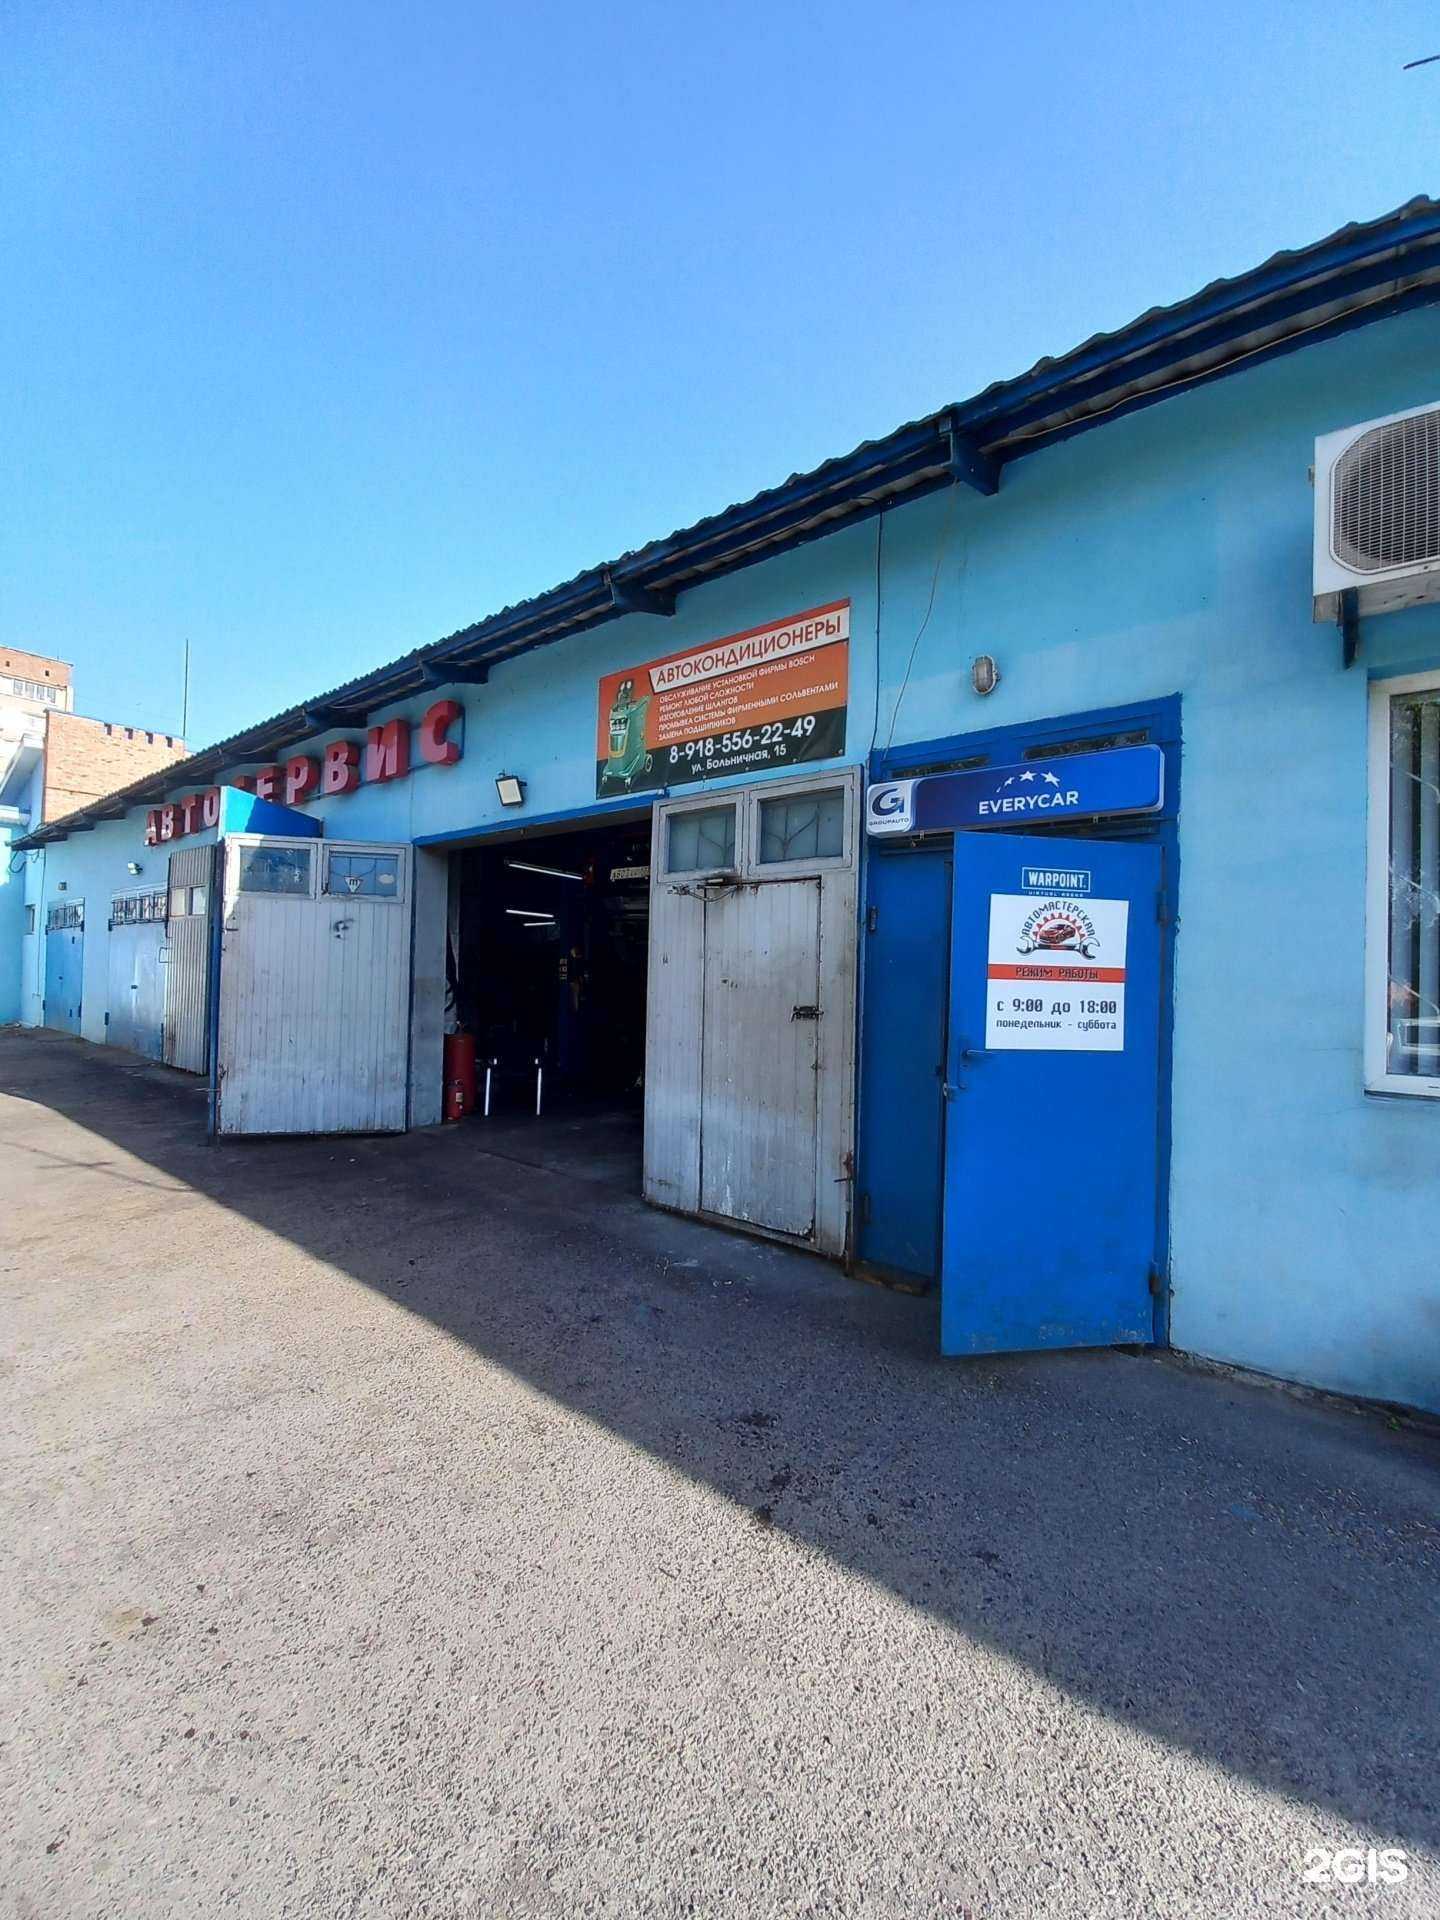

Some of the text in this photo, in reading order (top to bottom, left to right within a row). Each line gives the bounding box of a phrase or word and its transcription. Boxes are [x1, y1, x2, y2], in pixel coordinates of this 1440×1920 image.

[656, 615, 841, 687] АВТОКОНДИЦИОНЕРЫ
[712, 671, 758, 690] УСТАНОВКОЙ
[758, 663, 788, 678] ФИРМЫ
[788, 655, 816, 669] BOSCH
[659, 682, 755, 713] РЕМОНТ ЛЮБОЙ СЛОЖНОСТИ
[694, 710, 726, 724] СИСТЕМЫ
[726, 697, 780, 715] ФИРМЕННЫМИ
[779, 680, 839, 702] СОЛЬВЕНТАМИ
[705, 696, 738, 710] ШЛАНГОВ
[669, 715, 816, 764] 8-918-556-22-49
[691, 744, 787, 775] ул. Больничная, 15
[978, 790, 1080, 815] EVERYCAR
[868, 817, 911, 826] GROUPAUTO
[1028, 871, 1084, 888] WARPOINT
[1021, 900, 1096, 938] АВТОМАСТЕРСКАЯ
[1015, 967, 1099, 980] РЕЖИМ РАБОТЫ
[1012, 998, 1043, 1012] 9:00
[1051, 1001, 1071, 1015] до
[1079, 1000, 1117, 1014] 18:00
[996, 1019, 1062, 1030] понедельник
[1077, 1018, 1117, 1032] суббота
